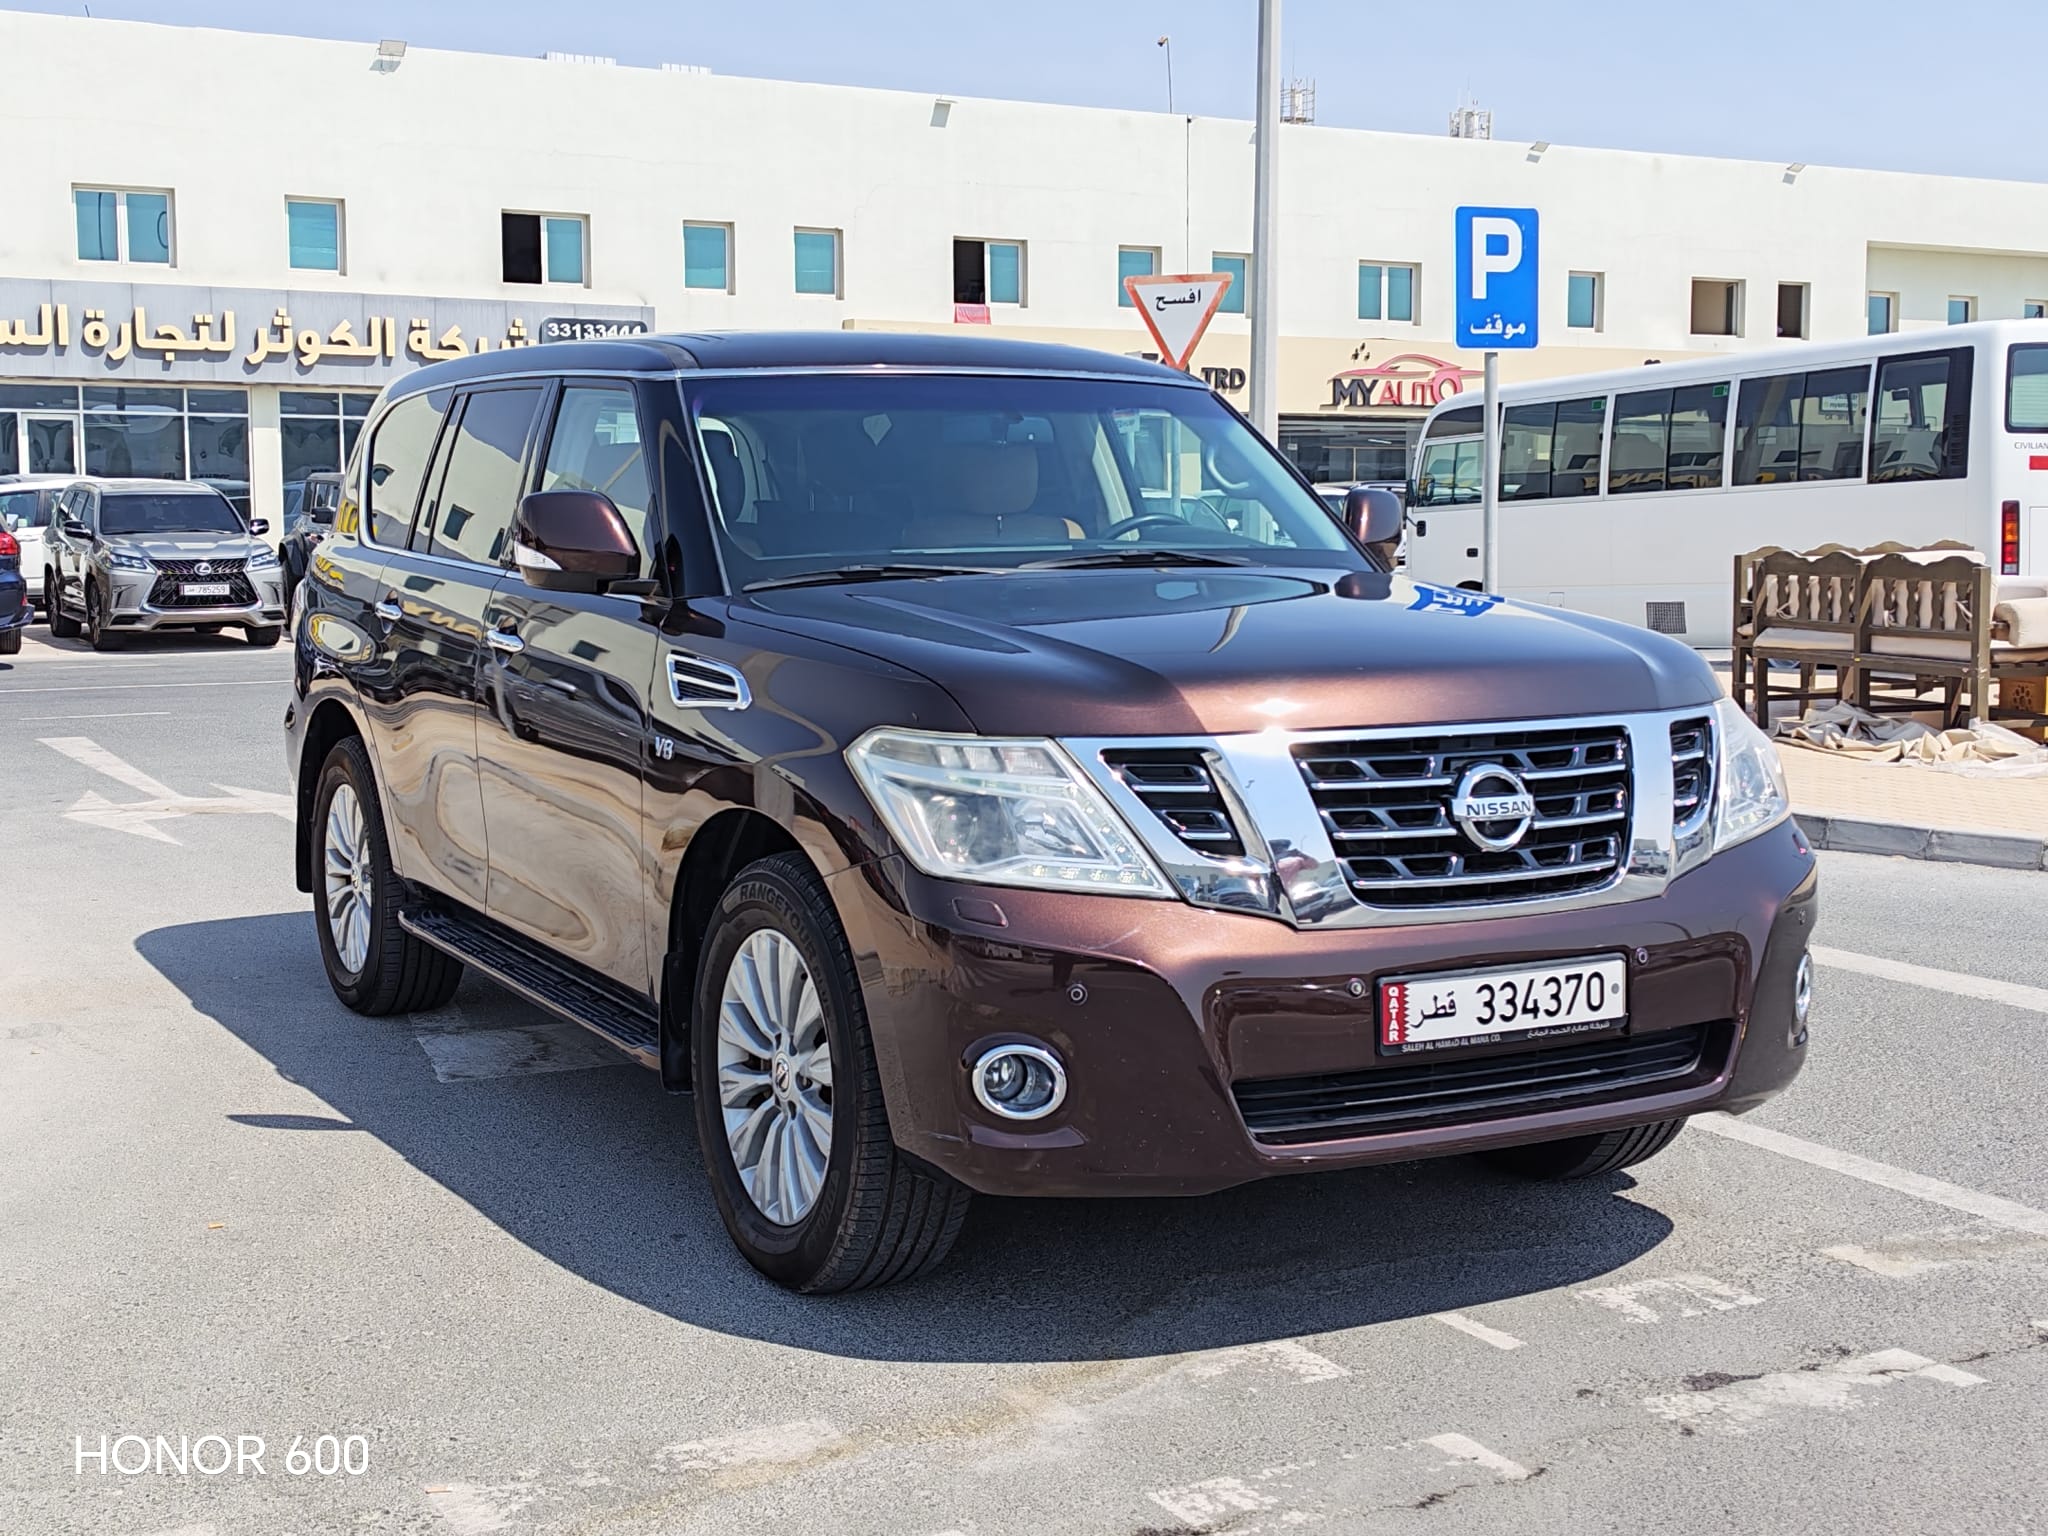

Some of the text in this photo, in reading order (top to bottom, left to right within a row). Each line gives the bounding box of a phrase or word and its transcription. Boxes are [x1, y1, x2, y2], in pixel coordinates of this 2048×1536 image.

[1472, 216, 1523, 300] P
[1155, 288, 1201, 312] افسح
[83, 306, 236, 361] لتجارة
[245, 308, 395, 366] الكوثر
[1470, 313, 1527, 340] موقف
[1201, 367, 1246, 390] TRD
[655, 736, 674, 760] V8
[1466, 800, 1531, 816] NISSAN
[1388, 986, 1399, 1042] QATAR
[1409, 990, 1457, 1029] قطر
[1475, 971, 1605, 1025] 334370
[1401, 1042, 1424, 1053] SALEH
[1425, 1041, 1434, 1050] AL
[1435, 1038, 1460, 1049] HAMAD
